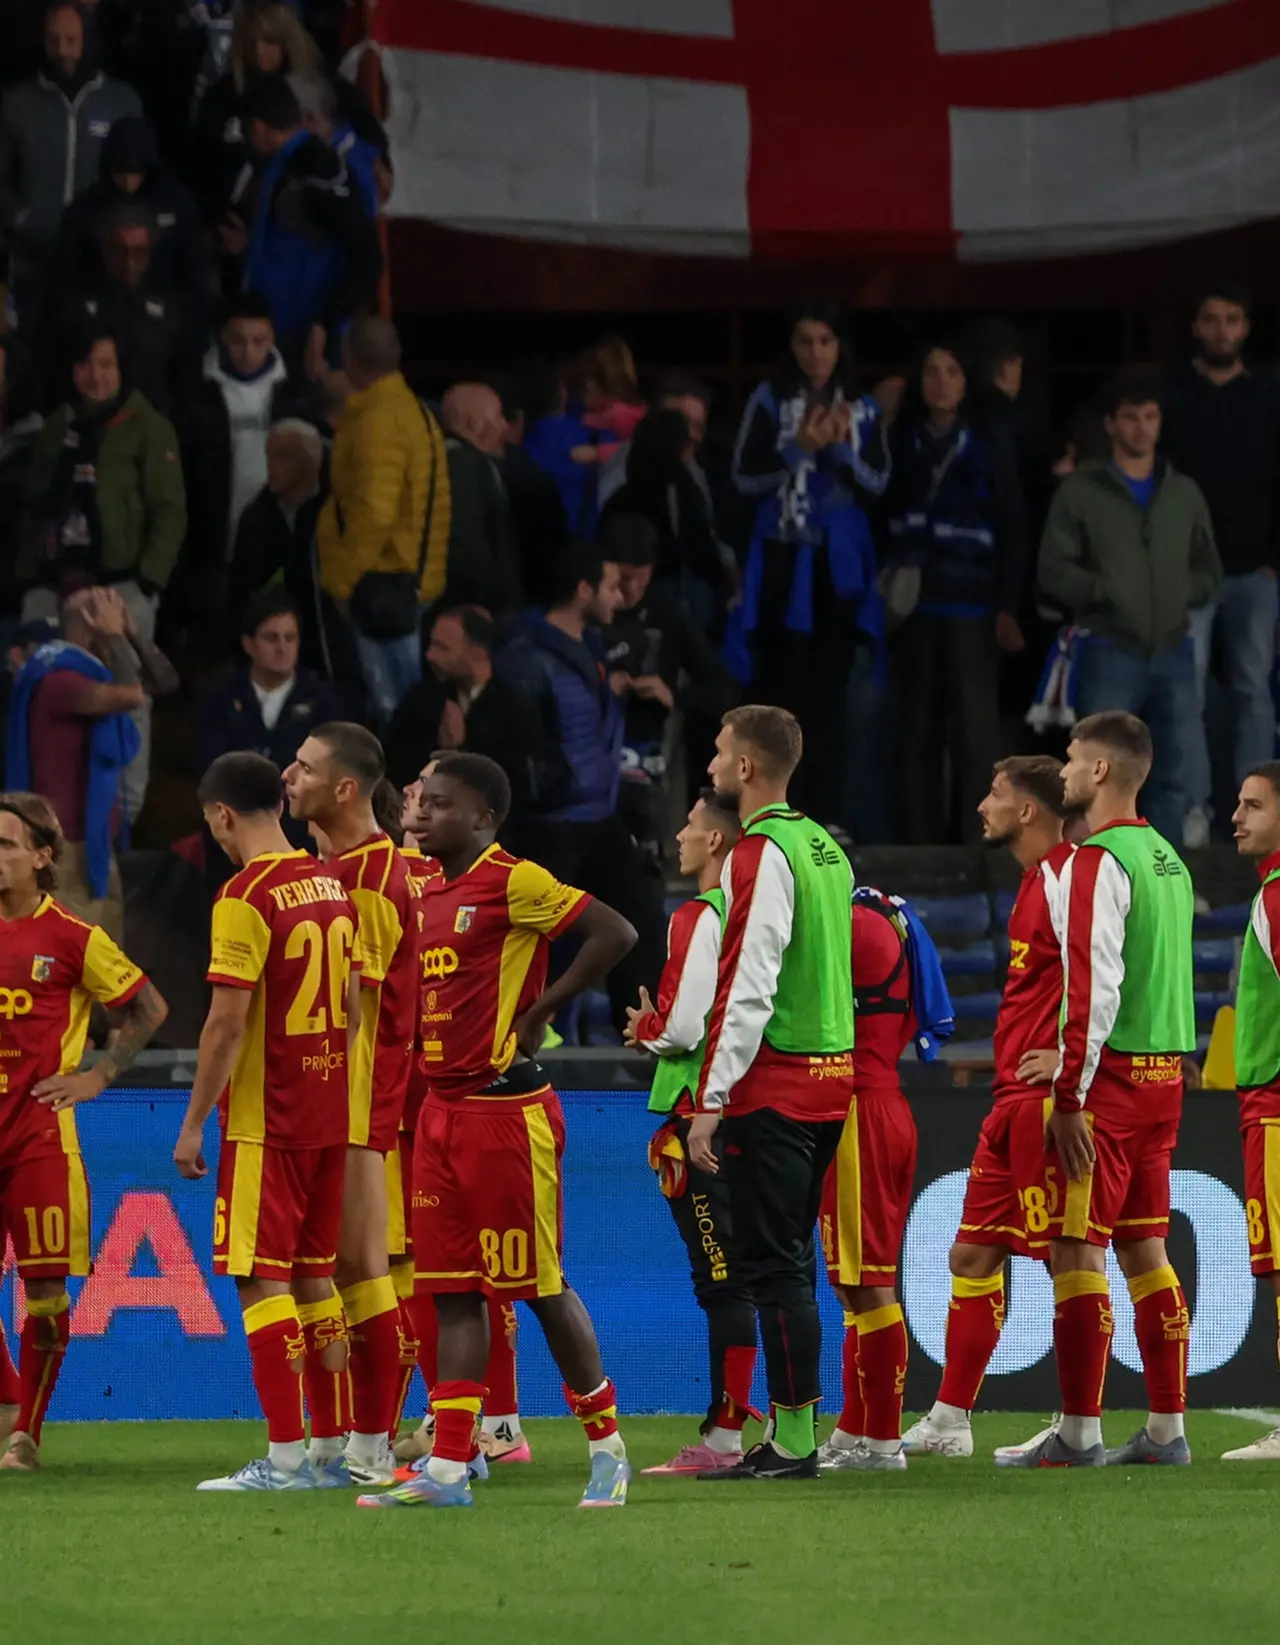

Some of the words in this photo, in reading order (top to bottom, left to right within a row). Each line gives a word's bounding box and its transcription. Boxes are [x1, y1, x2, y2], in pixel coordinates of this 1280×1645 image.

[284, 915, 354, 1036] 26
[419, 946, 459, 980] oop
[24, 1205, 65, 1256] 10
[1018, 1186, 1049, 1233] 8
[479, 1227, 528, 1279] 80
